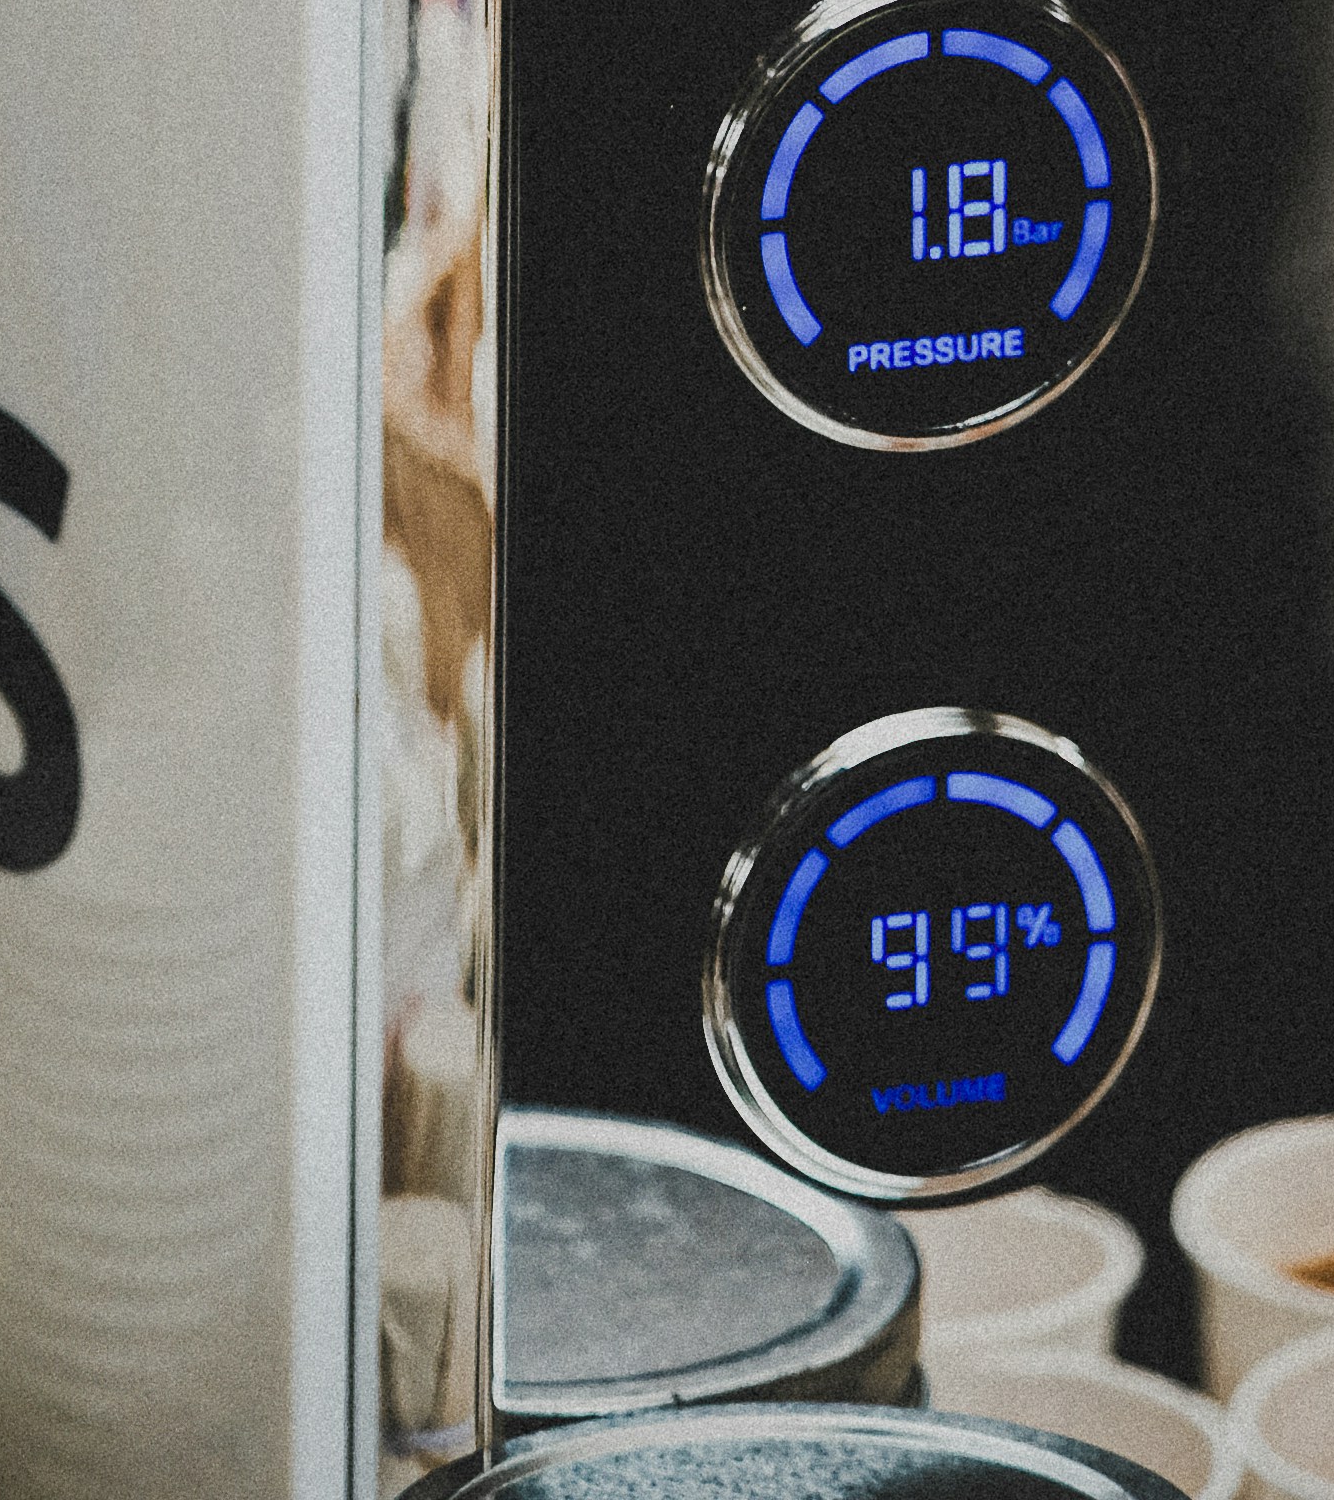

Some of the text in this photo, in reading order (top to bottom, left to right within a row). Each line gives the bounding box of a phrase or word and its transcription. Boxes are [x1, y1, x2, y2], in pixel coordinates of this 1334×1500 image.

[912, 159, 1064, 260] 1.8 Bar
[848, 327, 1025, 373] PRESSURE
[871, 1072, 1006, 1115] VOLUME
